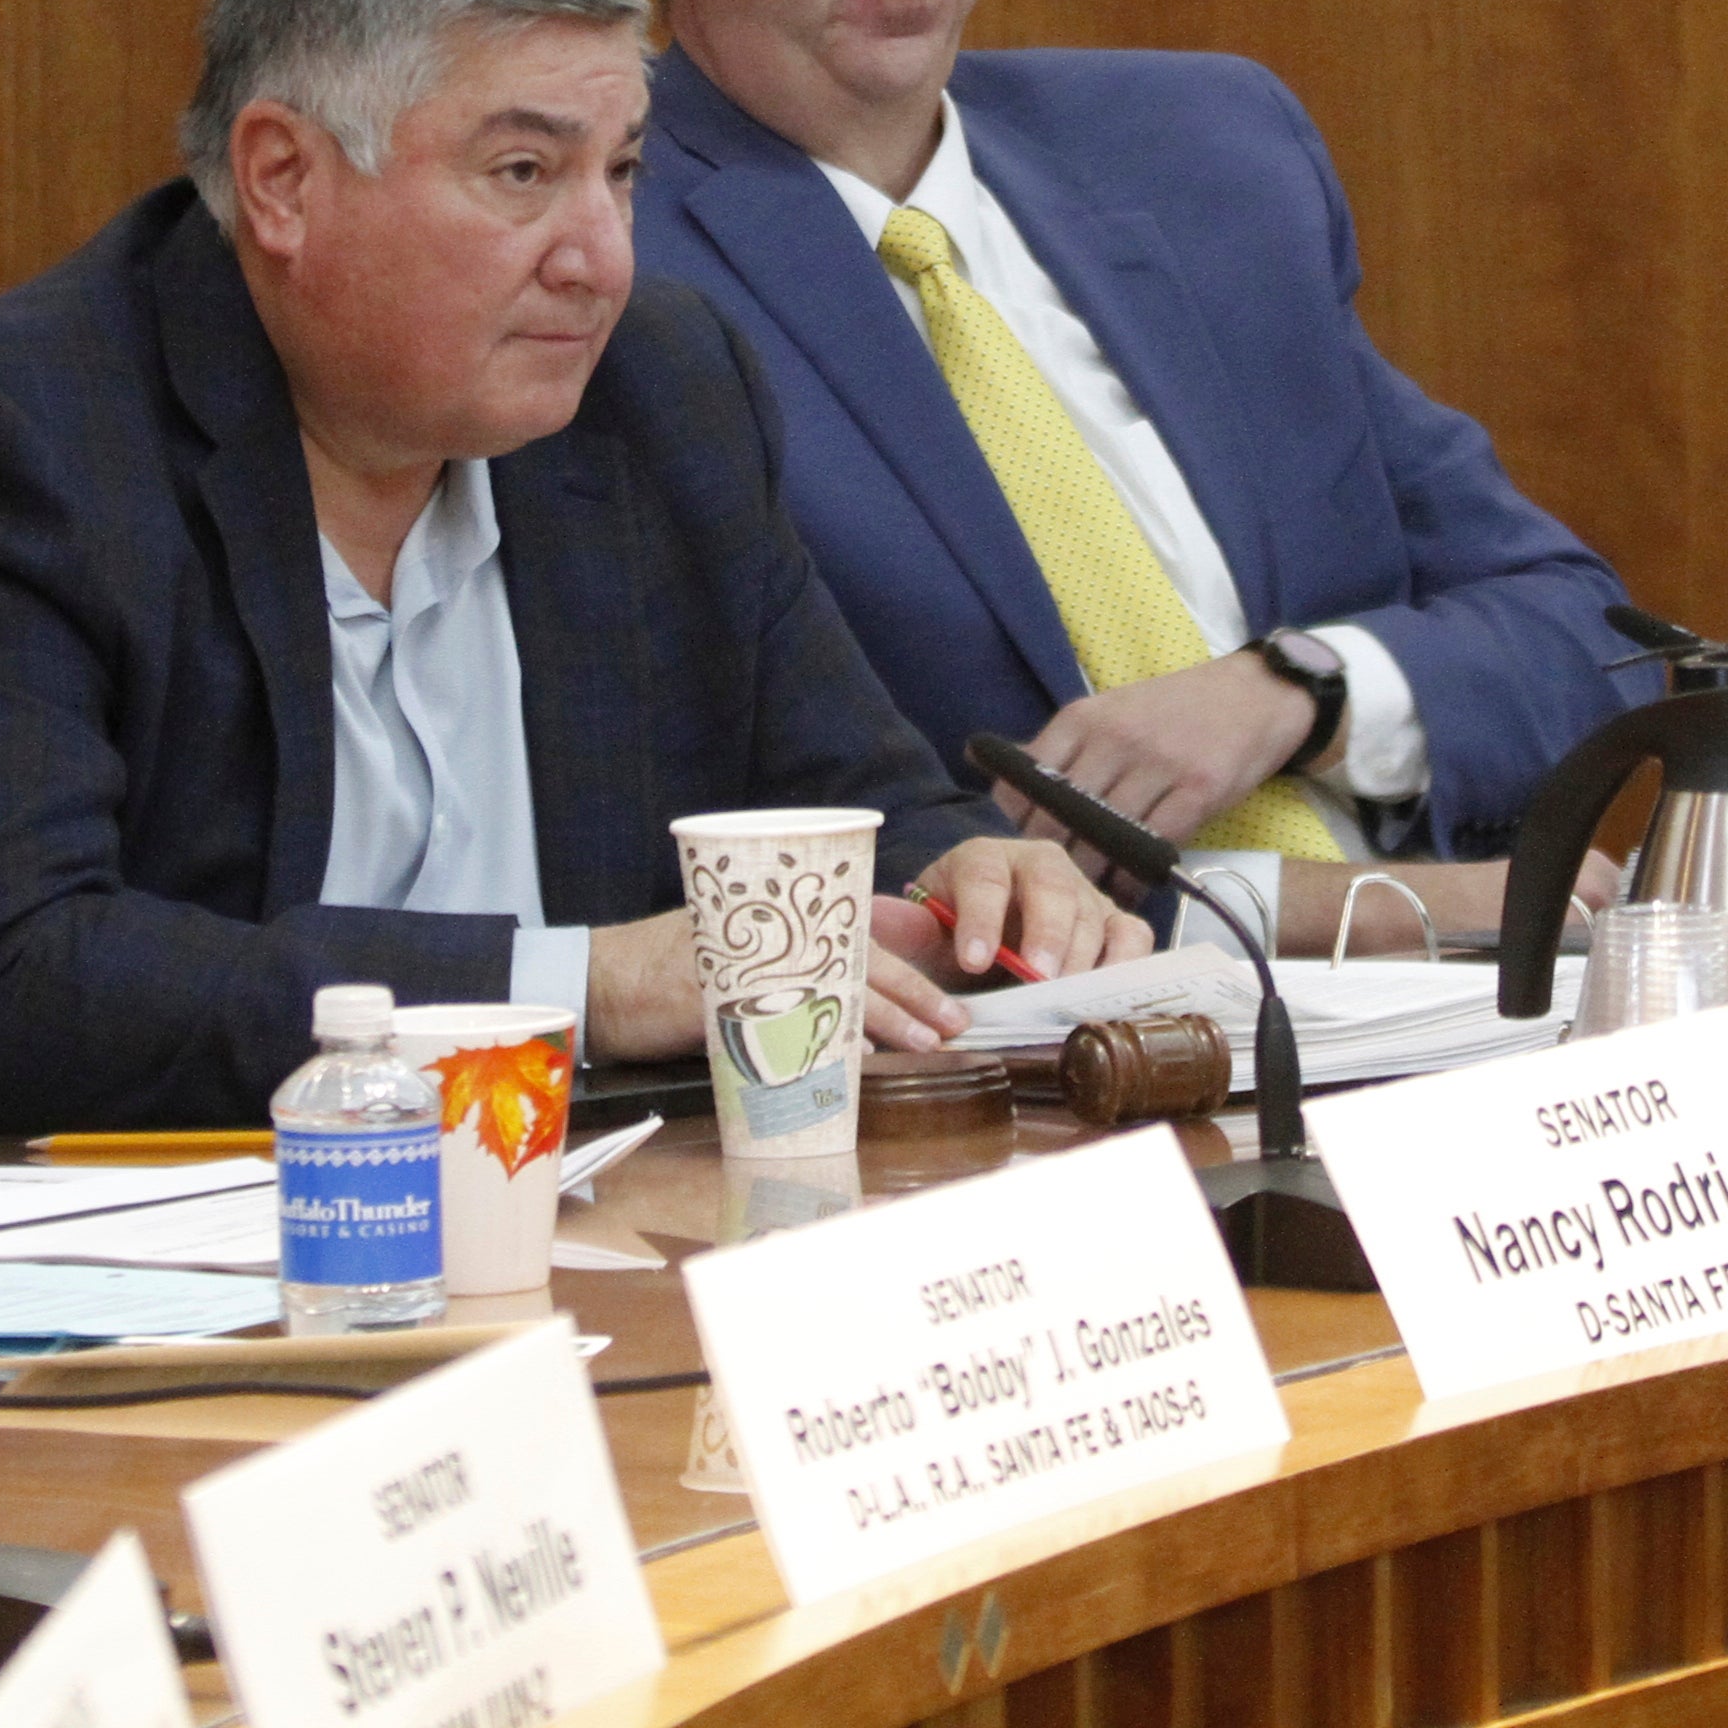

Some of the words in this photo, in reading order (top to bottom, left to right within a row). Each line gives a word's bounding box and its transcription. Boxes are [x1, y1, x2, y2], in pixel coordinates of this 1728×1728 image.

[1536, 1079, 1678, 1148] SENATOR
[358, 1219, 431, 1238] CASINO
[1453, 1204, 1605, 1284] Nancy
[920, 1257, 1032, 1325] SENATOR
[1575, 1274, 1706, 1343] D-SANTA
[785, 1384, 918, 1465] Roberto
[1046, 1328, 1075, 1385] J.
[1075, 1294, 1212, 1371] Gonzales
[985, 1425, 1064, 1485] SANTA
[1065, 1412, 1099, 1460] FE
[1100, 1406, 1125, 1449] &
[1122, 1378, 1207, 1441] TAOS-6
[322, 1605, 446, 1718] Steven
[472, 1517, 584, 1638] Neville
